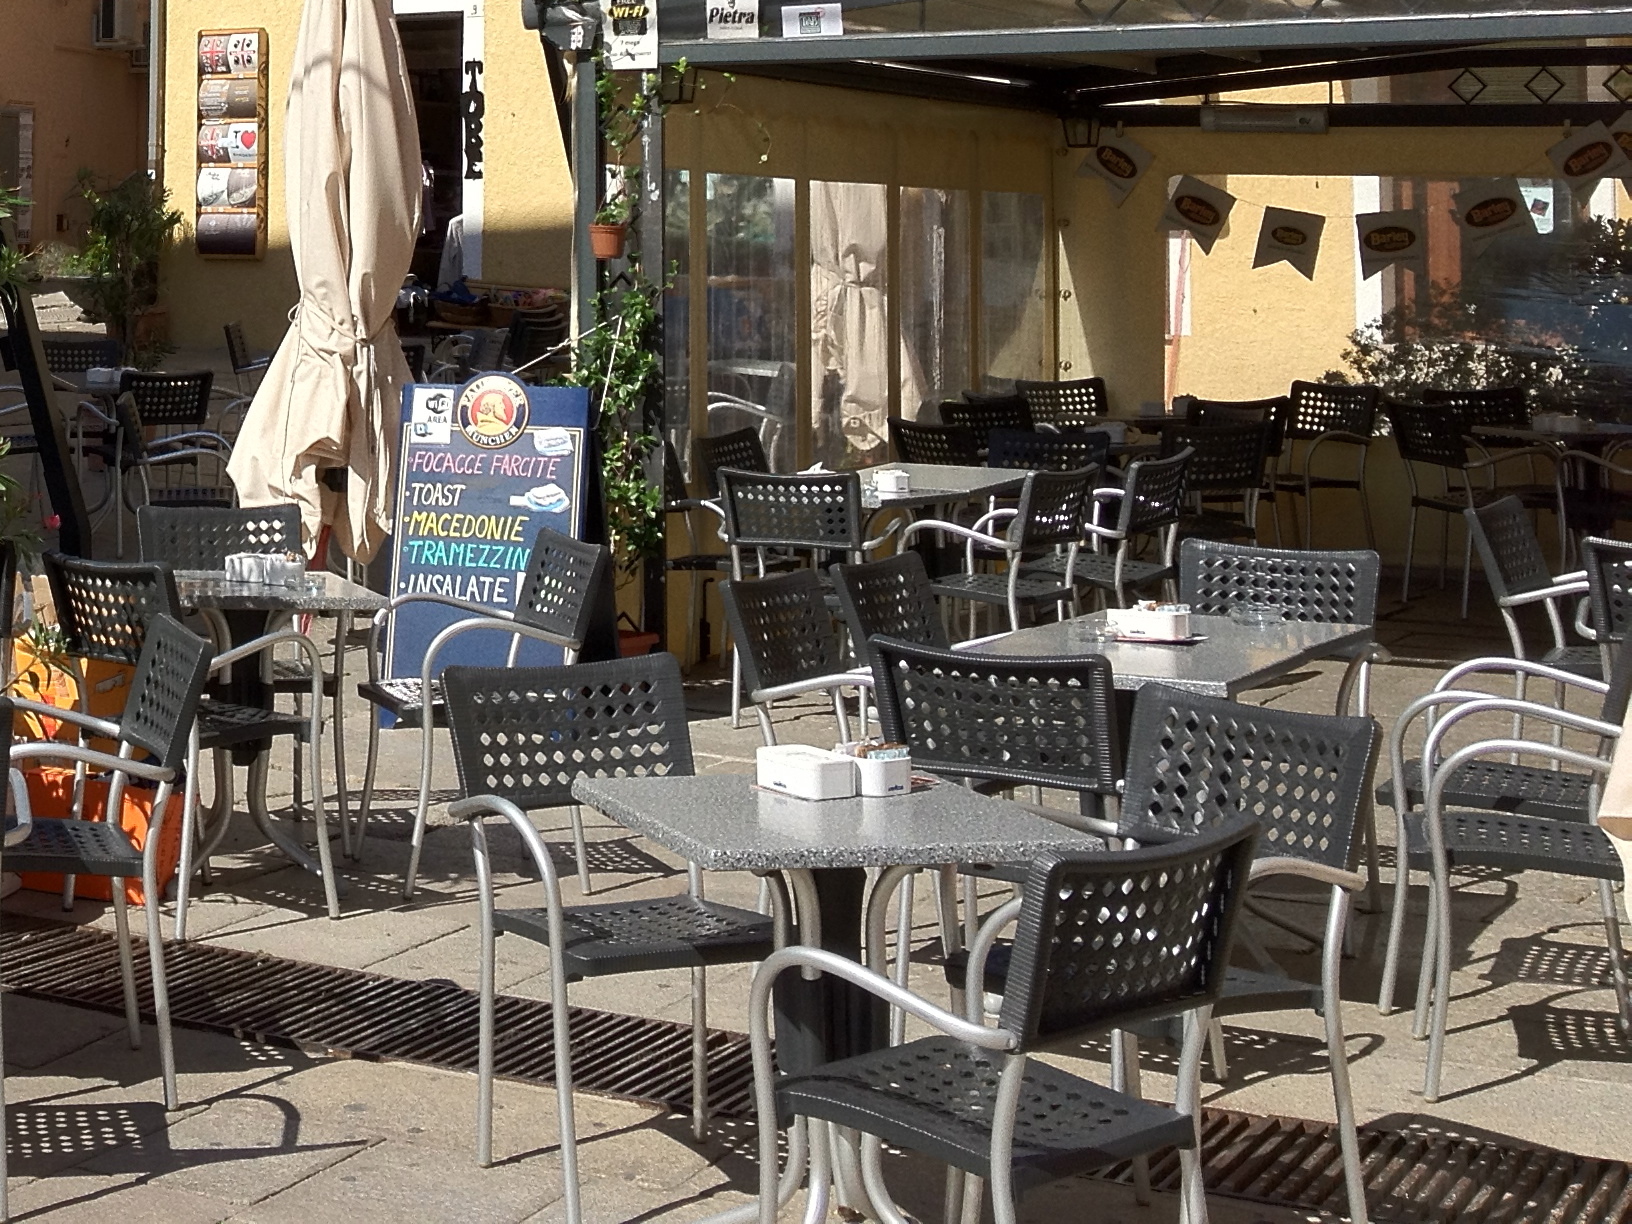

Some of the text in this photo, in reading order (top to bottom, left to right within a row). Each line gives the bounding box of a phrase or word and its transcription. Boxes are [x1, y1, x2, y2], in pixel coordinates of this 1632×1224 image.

[708, 6, 755, 25] Pietra
[412, 451, 561, 479] FOCACCE FARCITE
[411, 482, 467, 507] TOAST
[408, 511, 530, 542] MACEDONIE
[407, 573, 510, 603] INSALATE
